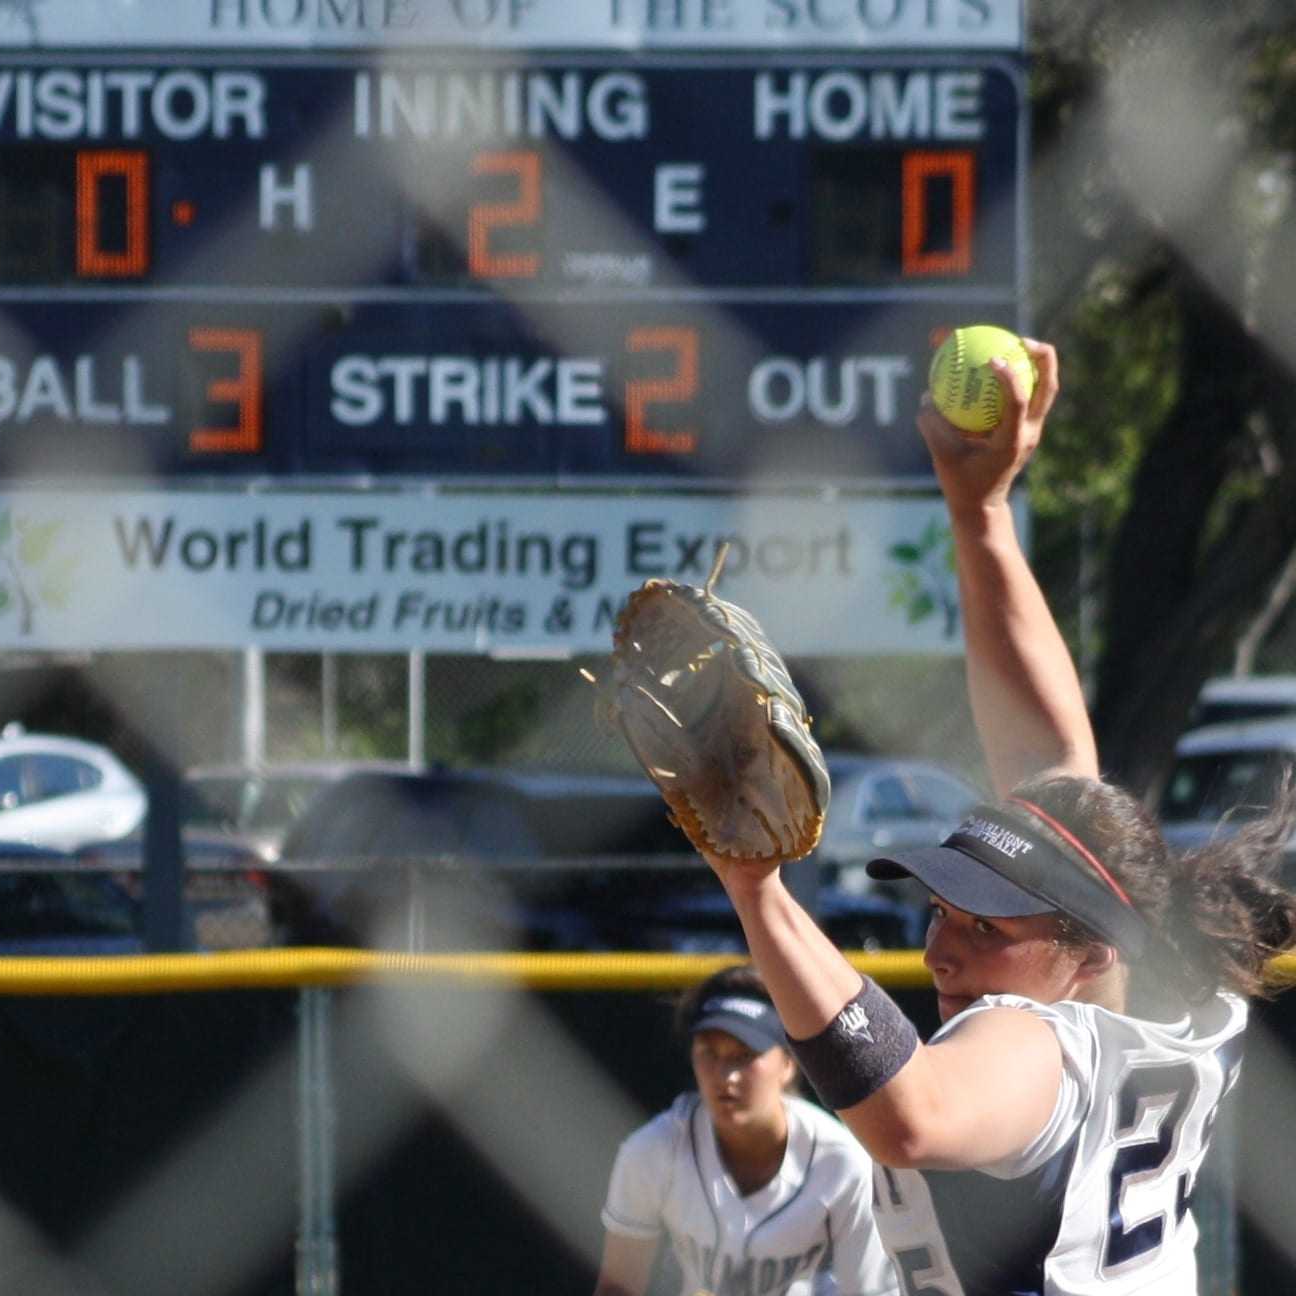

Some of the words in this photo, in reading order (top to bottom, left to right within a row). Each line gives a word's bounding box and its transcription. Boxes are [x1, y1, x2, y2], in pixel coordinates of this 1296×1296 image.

[354, 73, 650, 140] INNING
[754, 73, 985, 140] HOME
[75, 150, 149, 278] 0
[259, 164, 314, 231] H
[469, 150, 543, 278] 2
[653, 164, 704, 233] E
[901, 149, 975, 276] 0
[187, 327, 264, 453] 3
[330, 355, 607, 425] STRIKE
[624, 326, 701, 454] 2
[747, 356, 912, 425] OUT
[113, 517, 312, 573] World
[336, 517, 598, 590] Trading
[624, 521, 855, 592] Export
[251, 592, 378, 630] Dried
[392, 592, 526, 632] Fruits
[543, 597, 574, 634] &
[960, 825, 1018, 859] FTBALL
[966, 815, 1034, 854] ARLMONT
